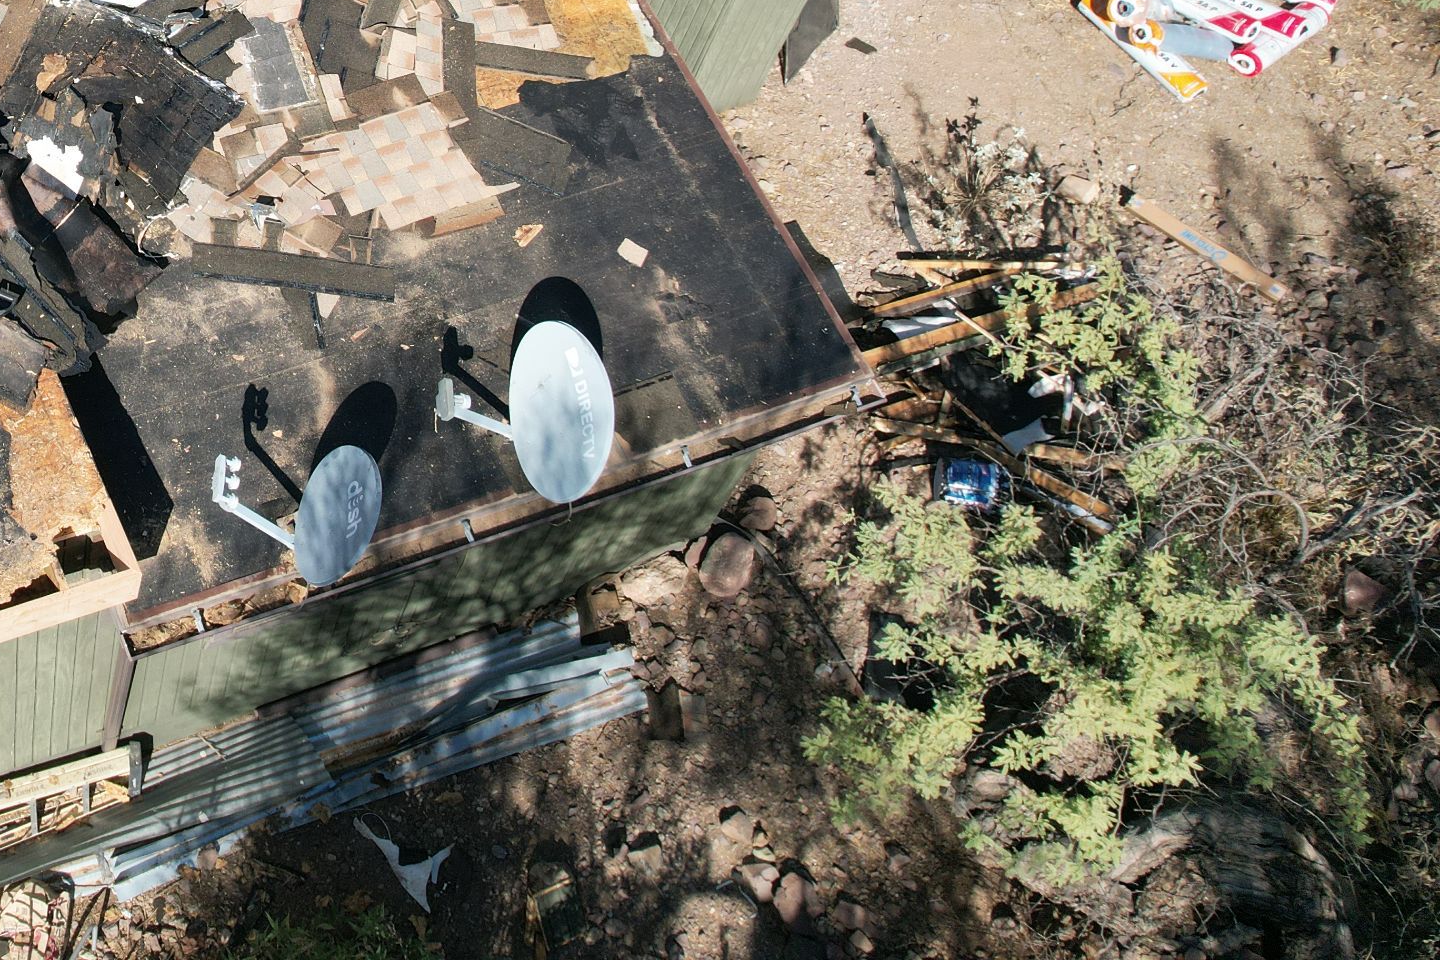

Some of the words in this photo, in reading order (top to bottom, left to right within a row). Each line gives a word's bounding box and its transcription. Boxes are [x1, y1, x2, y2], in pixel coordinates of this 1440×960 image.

[1240, 0, 1253, 9] SA
[575, 380, 595, 458] DIRECTV
[346, 480, 363, 538] dish
